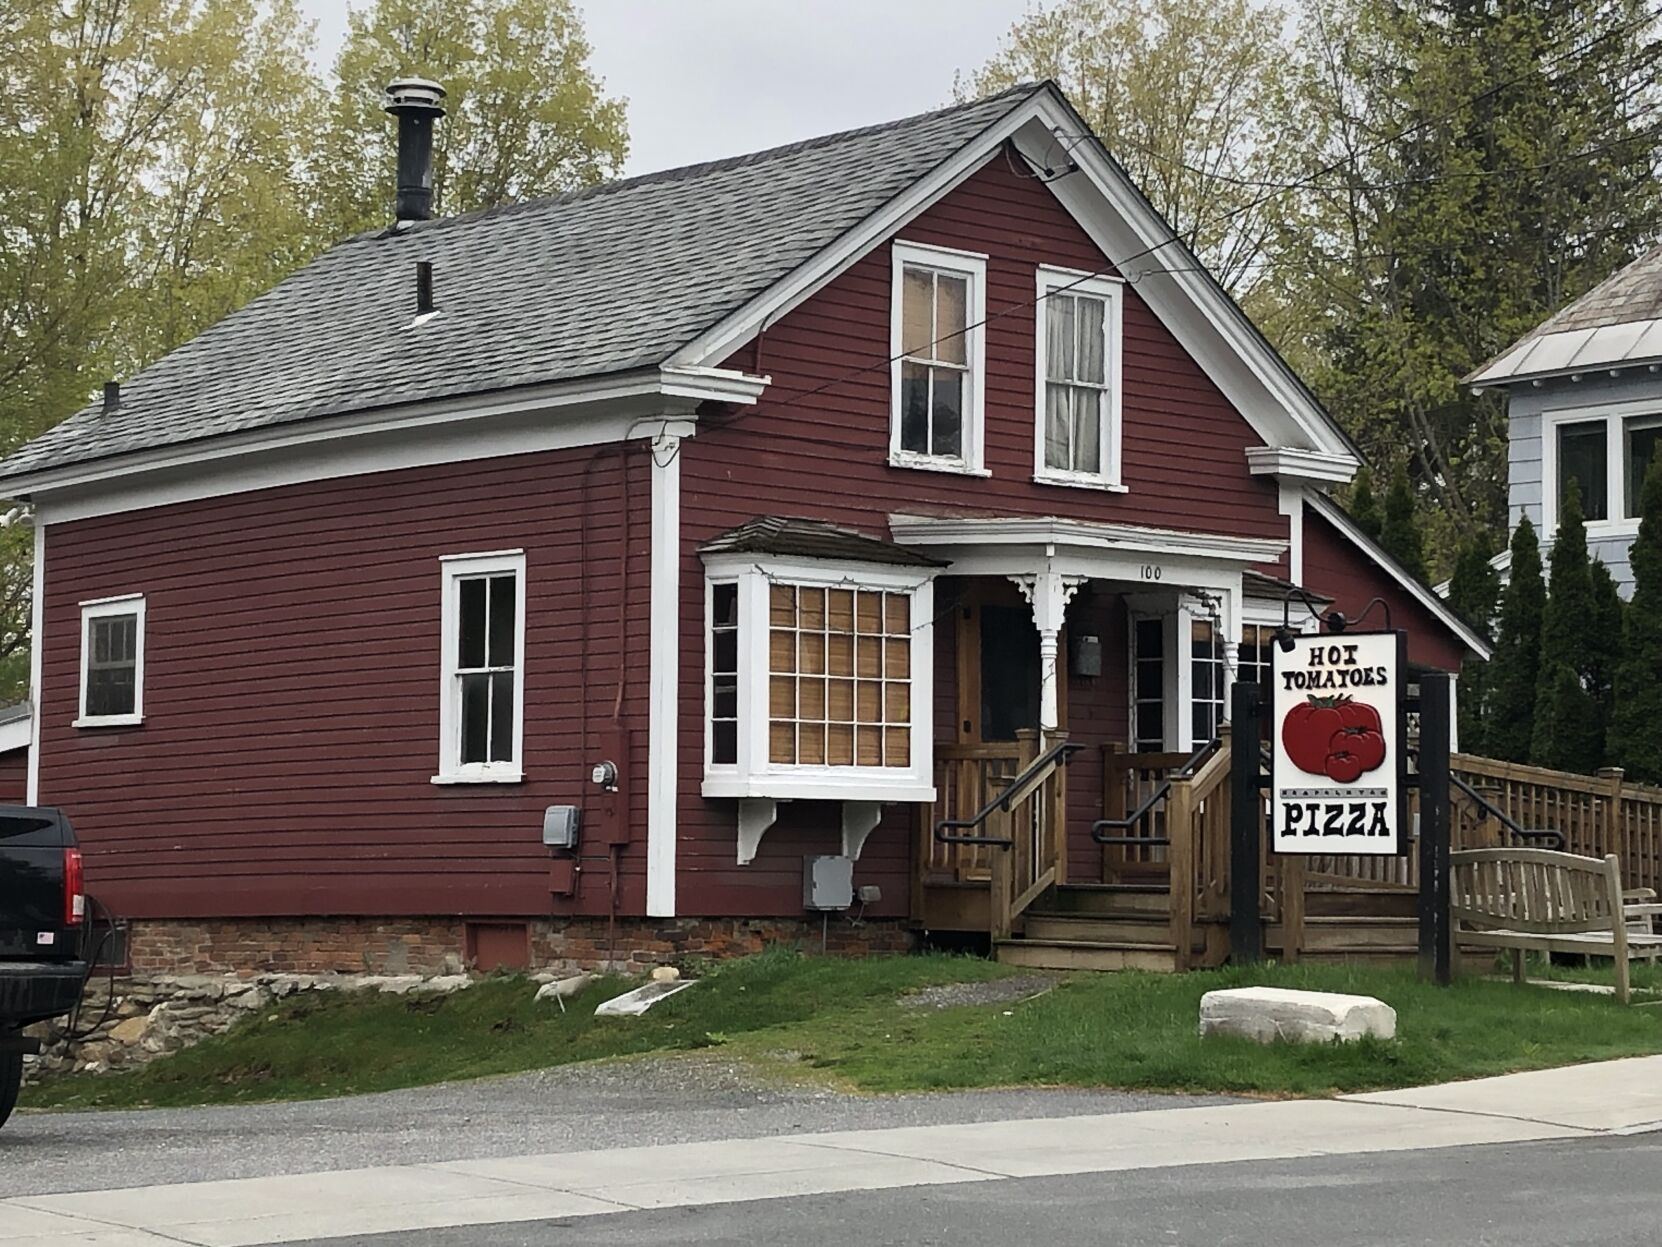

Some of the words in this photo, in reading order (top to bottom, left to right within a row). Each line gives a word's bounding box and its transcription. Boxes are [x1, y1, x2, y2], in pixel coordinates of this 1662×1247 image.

[1140, 565, 1161, 580] 100
[1308, 644, 1359, 667] HOT
[1281, 666, 1388, 691] TOMATOES
[1280, 802, 1390, 838] PIZZA
